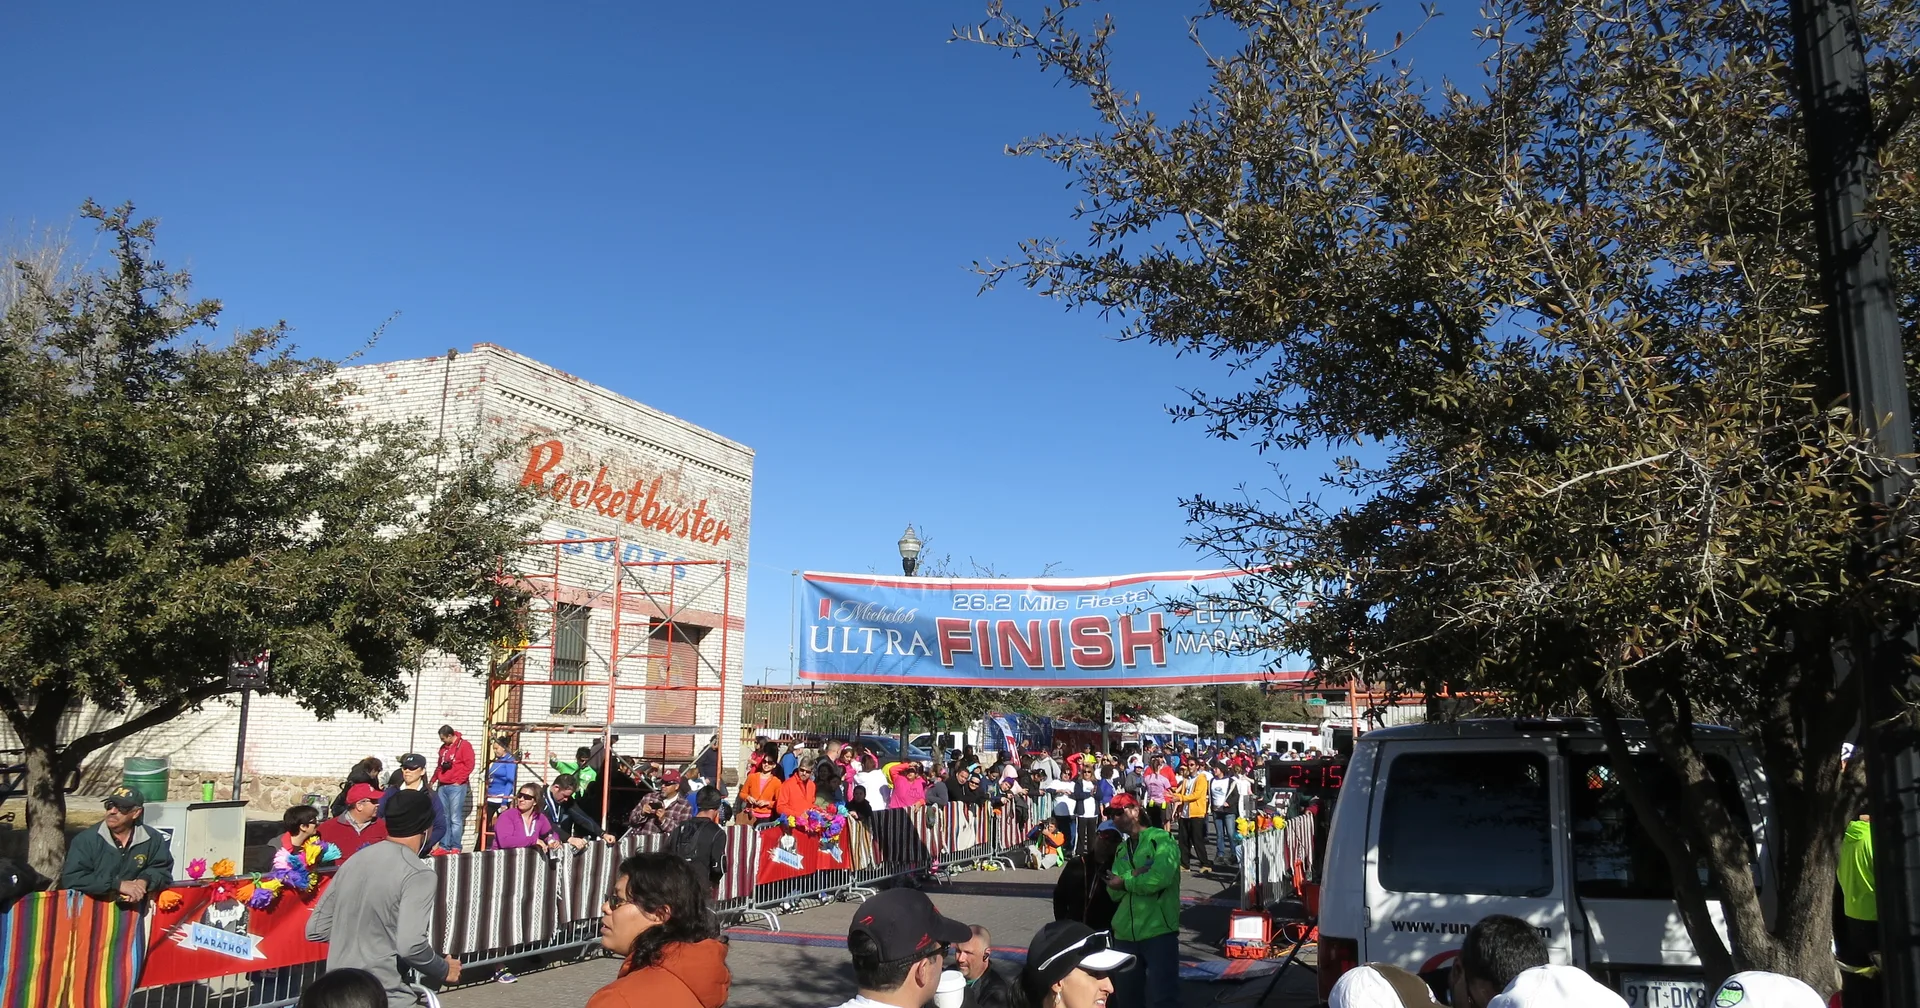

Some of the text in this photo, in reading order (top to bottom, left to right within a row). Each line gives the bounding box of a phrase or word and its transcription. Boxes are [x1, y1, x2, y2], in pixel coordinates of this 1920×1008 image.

[519, 439, 733, 546] Rocketbuster
[561, 527, 687, 580] BOOTS
[833, 599, 910, 624] Michelob
[952, 588, 1150, 612] 26.2 Mile Fiesta
[1195, 600, 1222, 624] EL
[810, 625, 933, 656] ULTRA
[935, 611, 1168, 672] FINISH
[1288, 765, 1343, 788] 2:15
[212, 909, 239, 919] ULTRA
[194, 935, 249, 956] MARATHON
